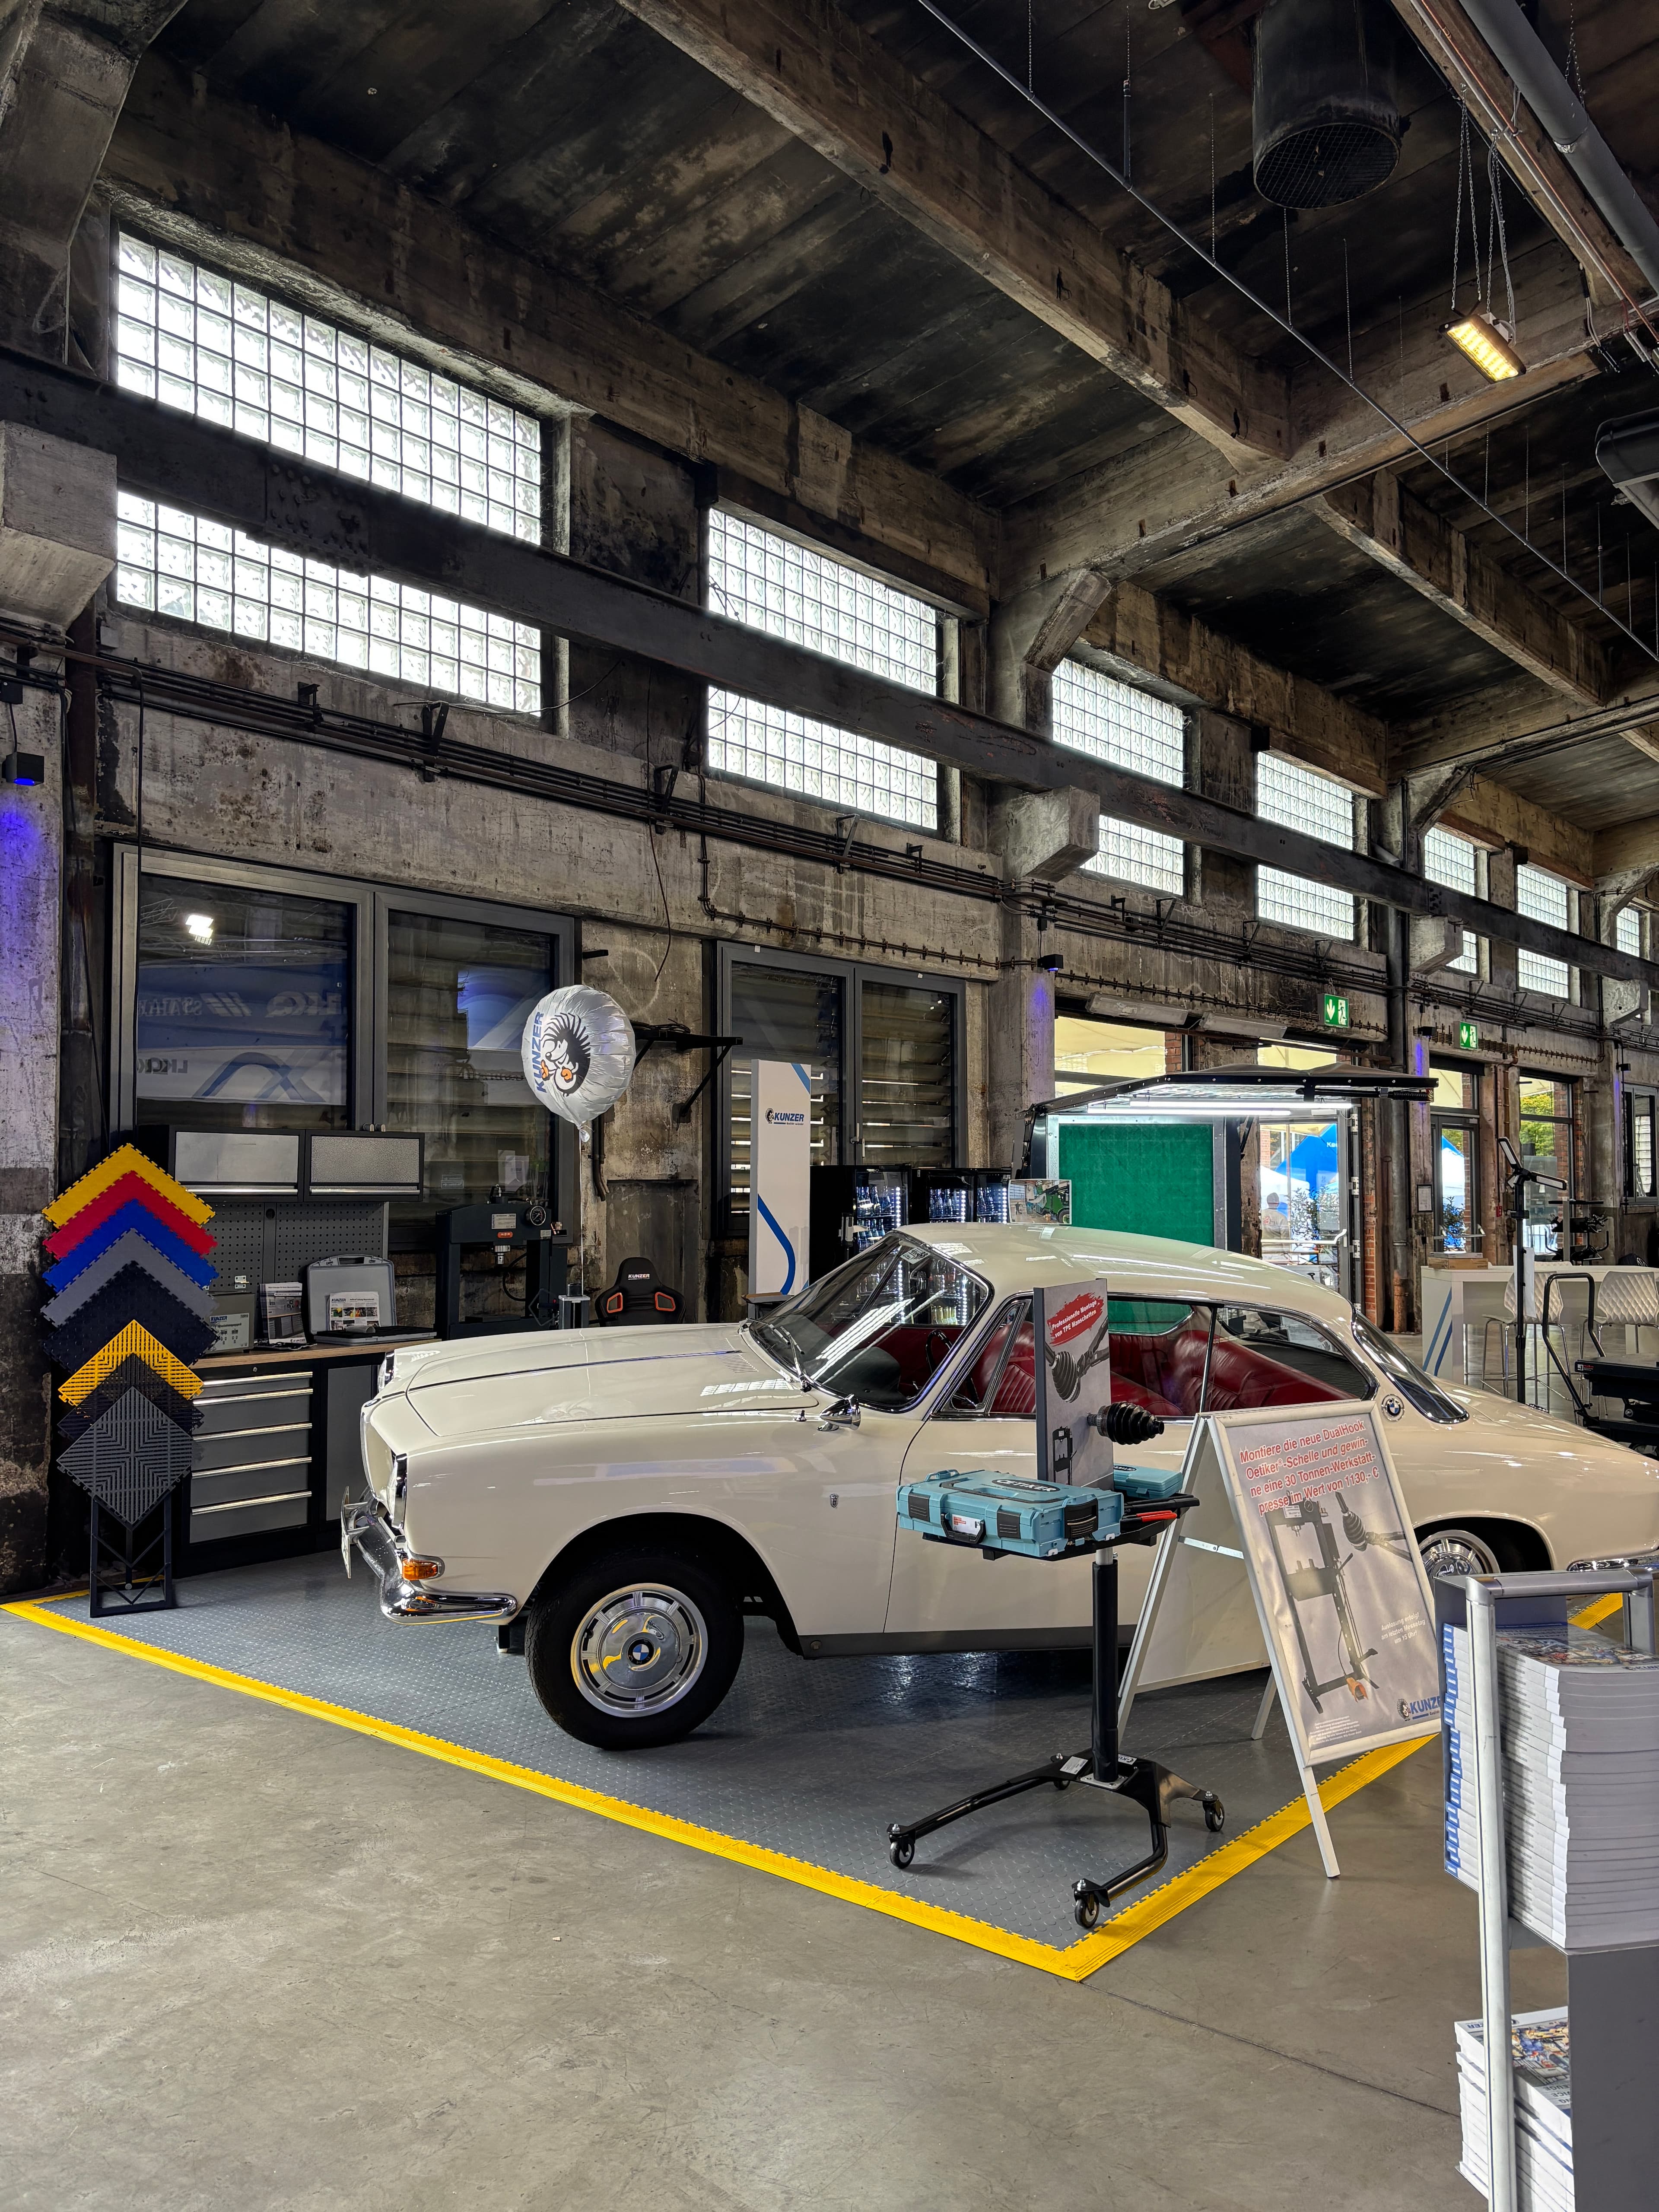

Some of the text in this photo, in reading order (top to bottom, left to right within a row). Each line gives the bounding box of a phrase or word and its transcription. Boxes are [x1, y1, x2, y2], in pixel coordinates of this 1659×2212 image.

[532, 1012, 547, 1093] KUNZER
[774, 1112, 804, 1122] KUNZER
[1052, 1300, 1097, 1330] Professionelle Montage
[1063, 1323, 1071, 1333] TPE
[1071, 1309, 1096, 1328] Manschetten
[1240, 1420, 1366, 1463] Montiere die neue DualHook
[1246, 1437, 1368, 1480] Oetiker®-Schelle und gewin-
[1250, 1452, 1376, 1498] ne eine 30 Tonnen-Werkstatt-
[1259, 1466, 1379, 1517] presse im Wert von 1130,- €
[1381, 1618, 1404, 1631] Auslosung
[1389, 1627, 1403, 1637] letzten
[1404, 1620, 1425, 1631] Messetag
[1408, 1630, 1417, 1639] Uhr!
